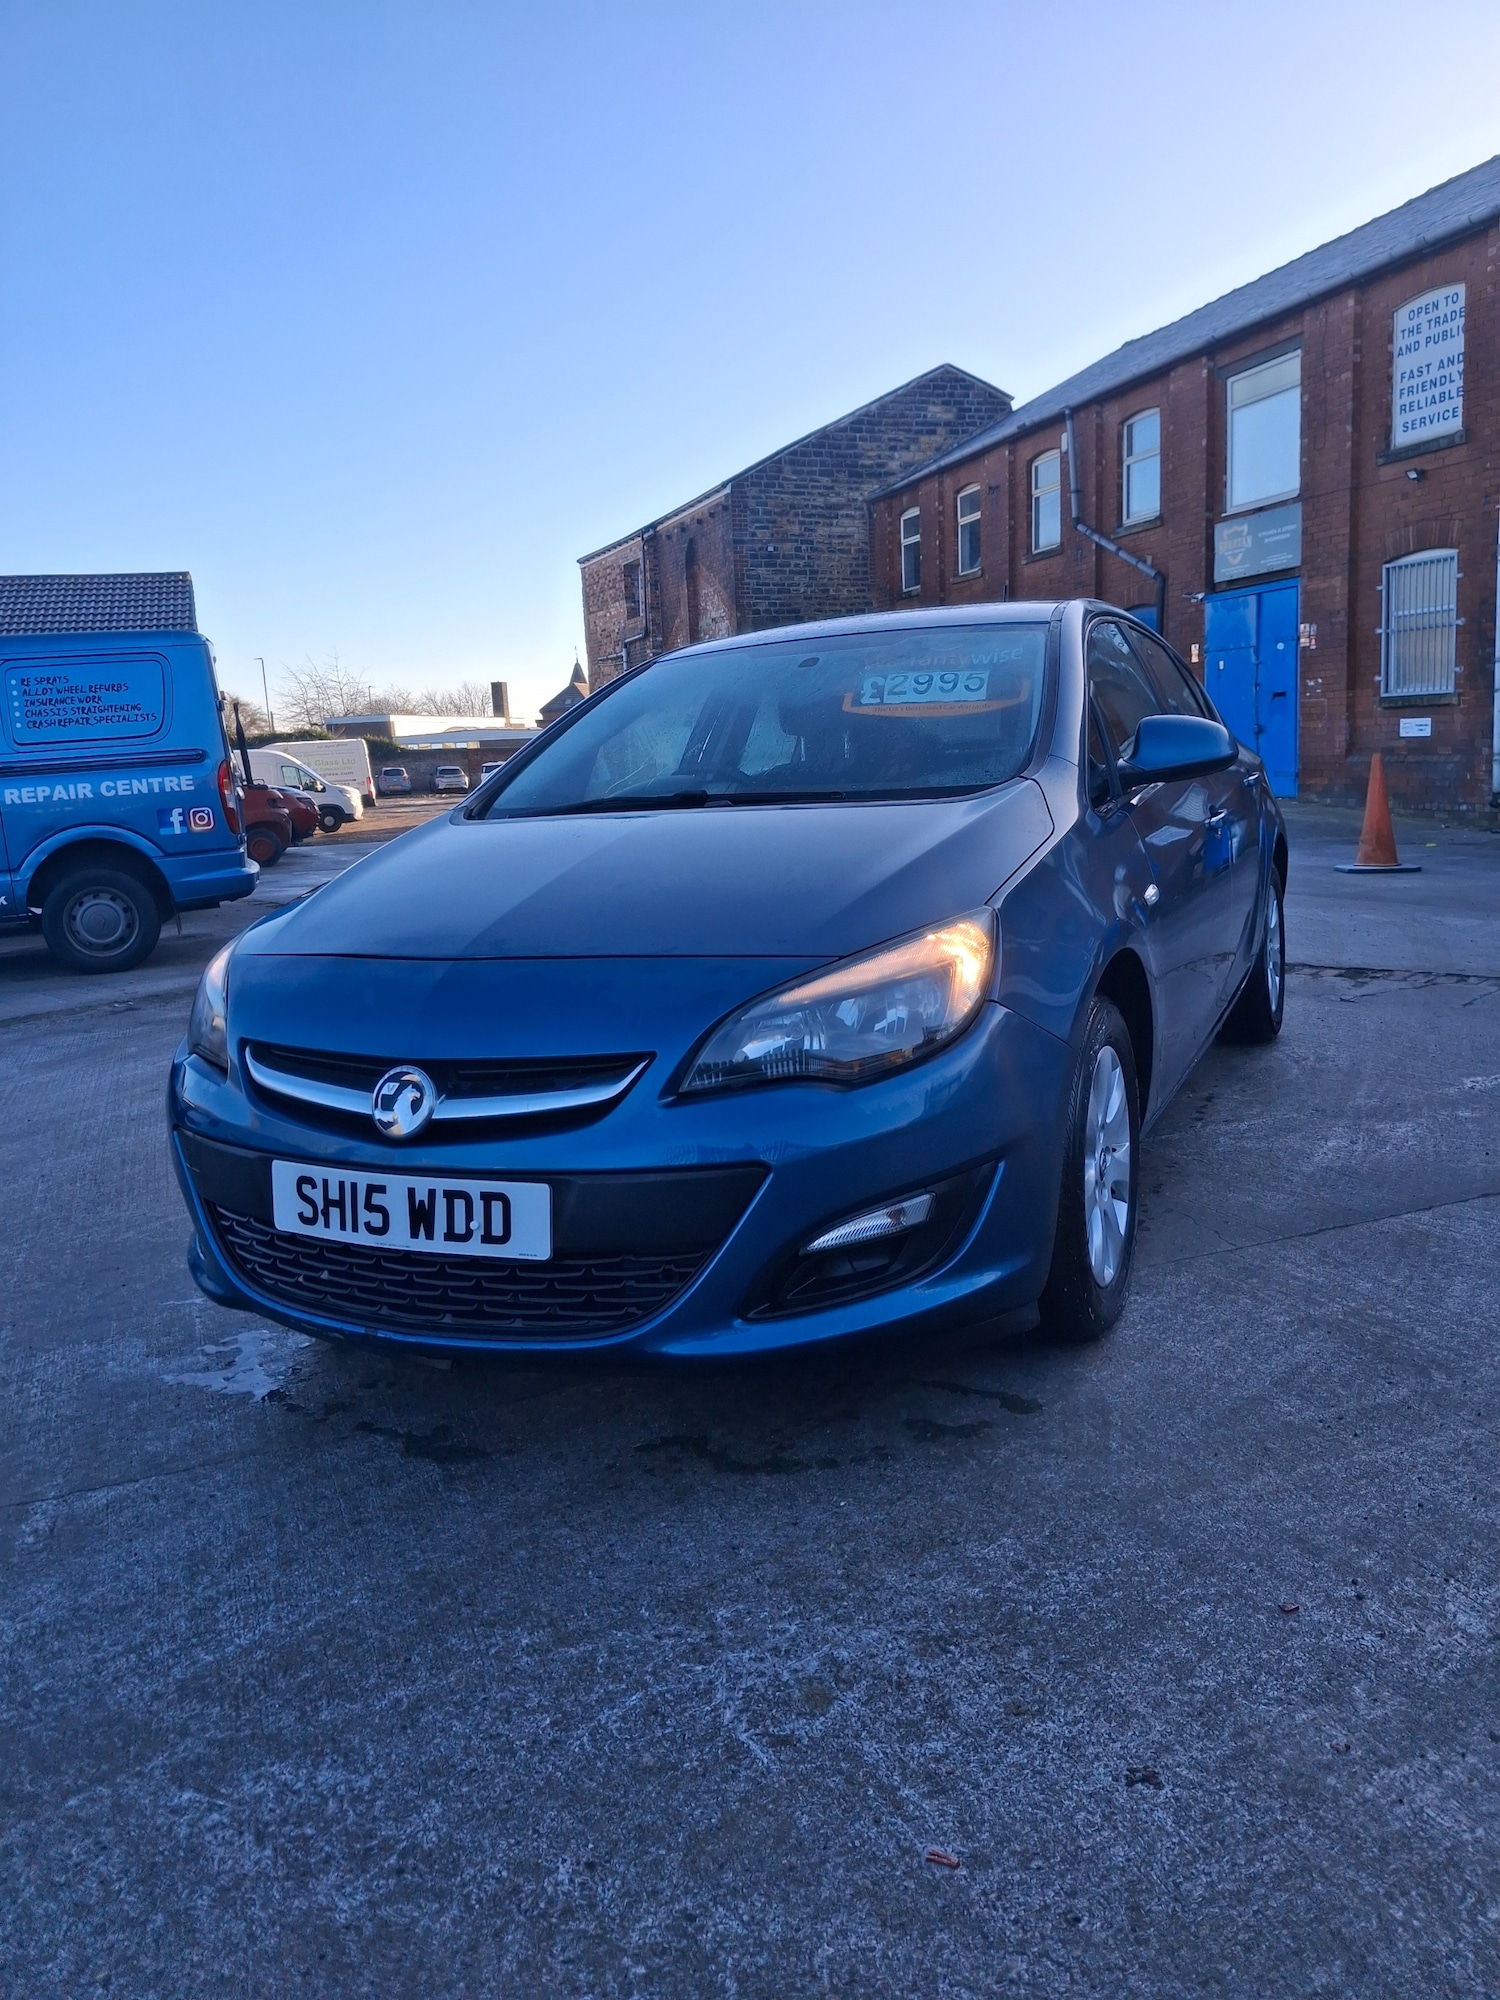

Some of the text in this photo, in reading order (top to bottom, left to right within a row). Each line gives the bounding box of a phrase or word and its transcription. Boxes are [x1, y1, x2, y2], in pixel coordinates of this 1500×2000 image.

[1408, 292, 1459, 321] OPEN TO
[1400, 307, 1465, 340] THE TRADE
[1397, 340, 1420, 358] AND
[1400, 352, 1464, 384] FAST AND
[1399, 369, 1464, 400] FRIENDLY
[1399, 385, 1464, 415] RELIABLE
[1402, 406, 1459, 433] SERVICE
[21, 675, 69, 687] RE SPRAYS
[22, 682, 129, 697] ALLOY WHEEL REFURBS
[860, 672, 987, 704] £2995
[24, 695, 103, 708] INSURANCE WORK
[25, 703, 142, 719] CHASSIS STRAIGHTENING
[26, 713, 157, 730] CRASH REPAIR SPECIALISTS
[4, 775, 195, 804] REPAIR CENTRE
[296, 1175, 512, 1245] SH15 WDD
